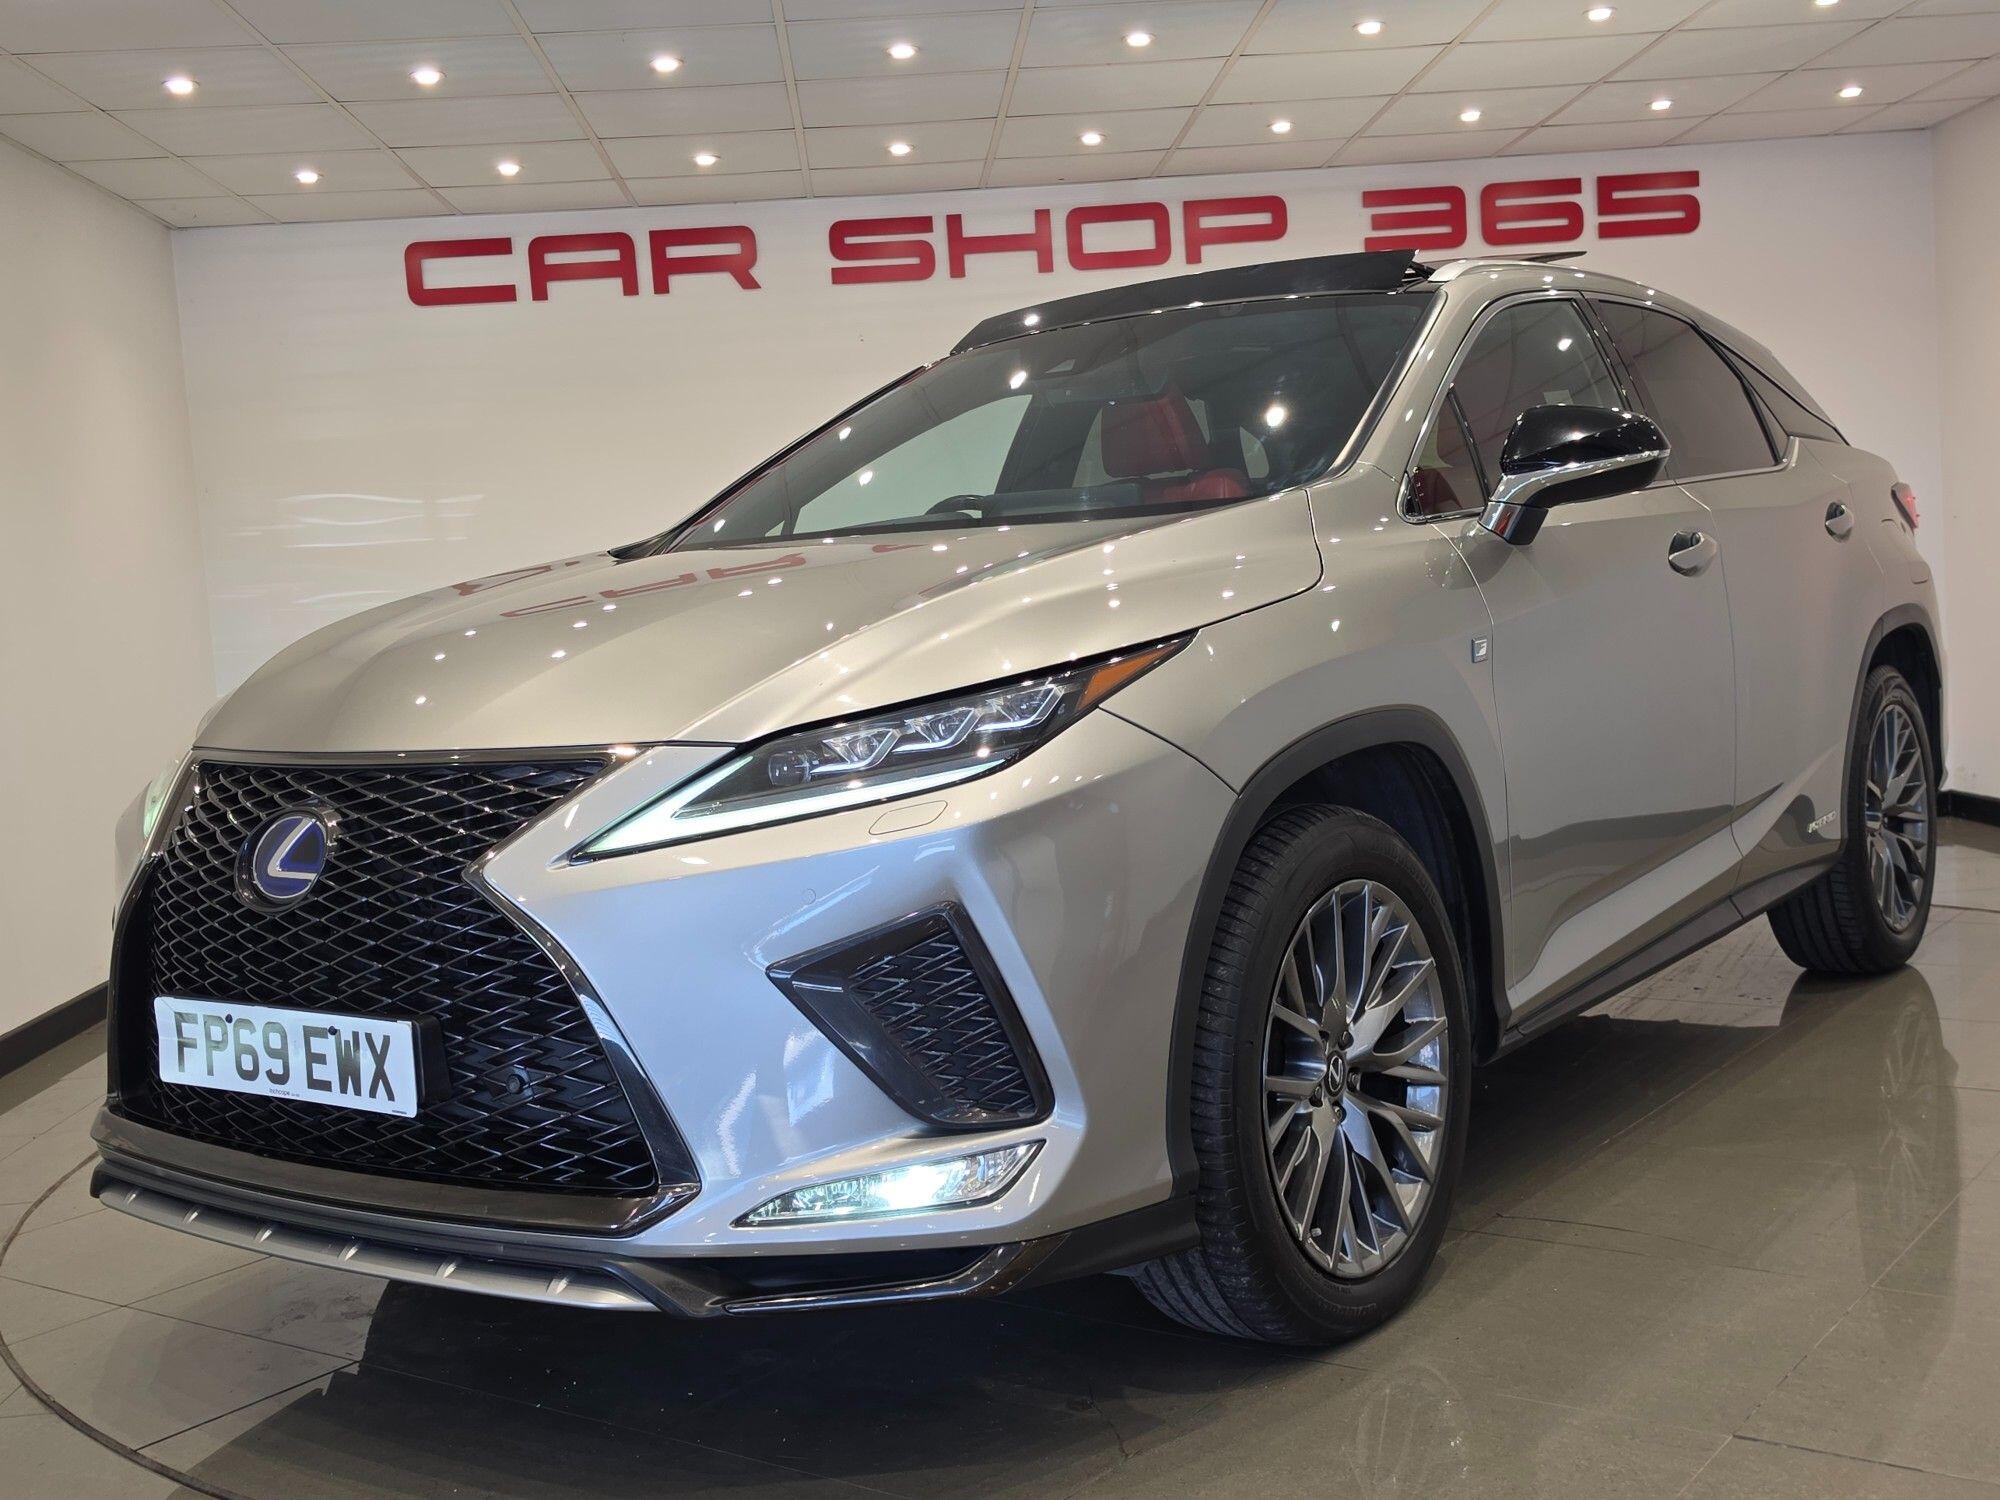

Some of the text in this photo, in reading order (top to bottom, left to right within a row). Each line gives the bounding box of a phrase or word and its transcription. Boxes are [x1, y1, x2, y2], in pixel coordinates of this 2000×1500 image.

[404, 170, 1701, 307] CAR SHOP 365
[174, 1011, 395, 1102] FP69 EWX
